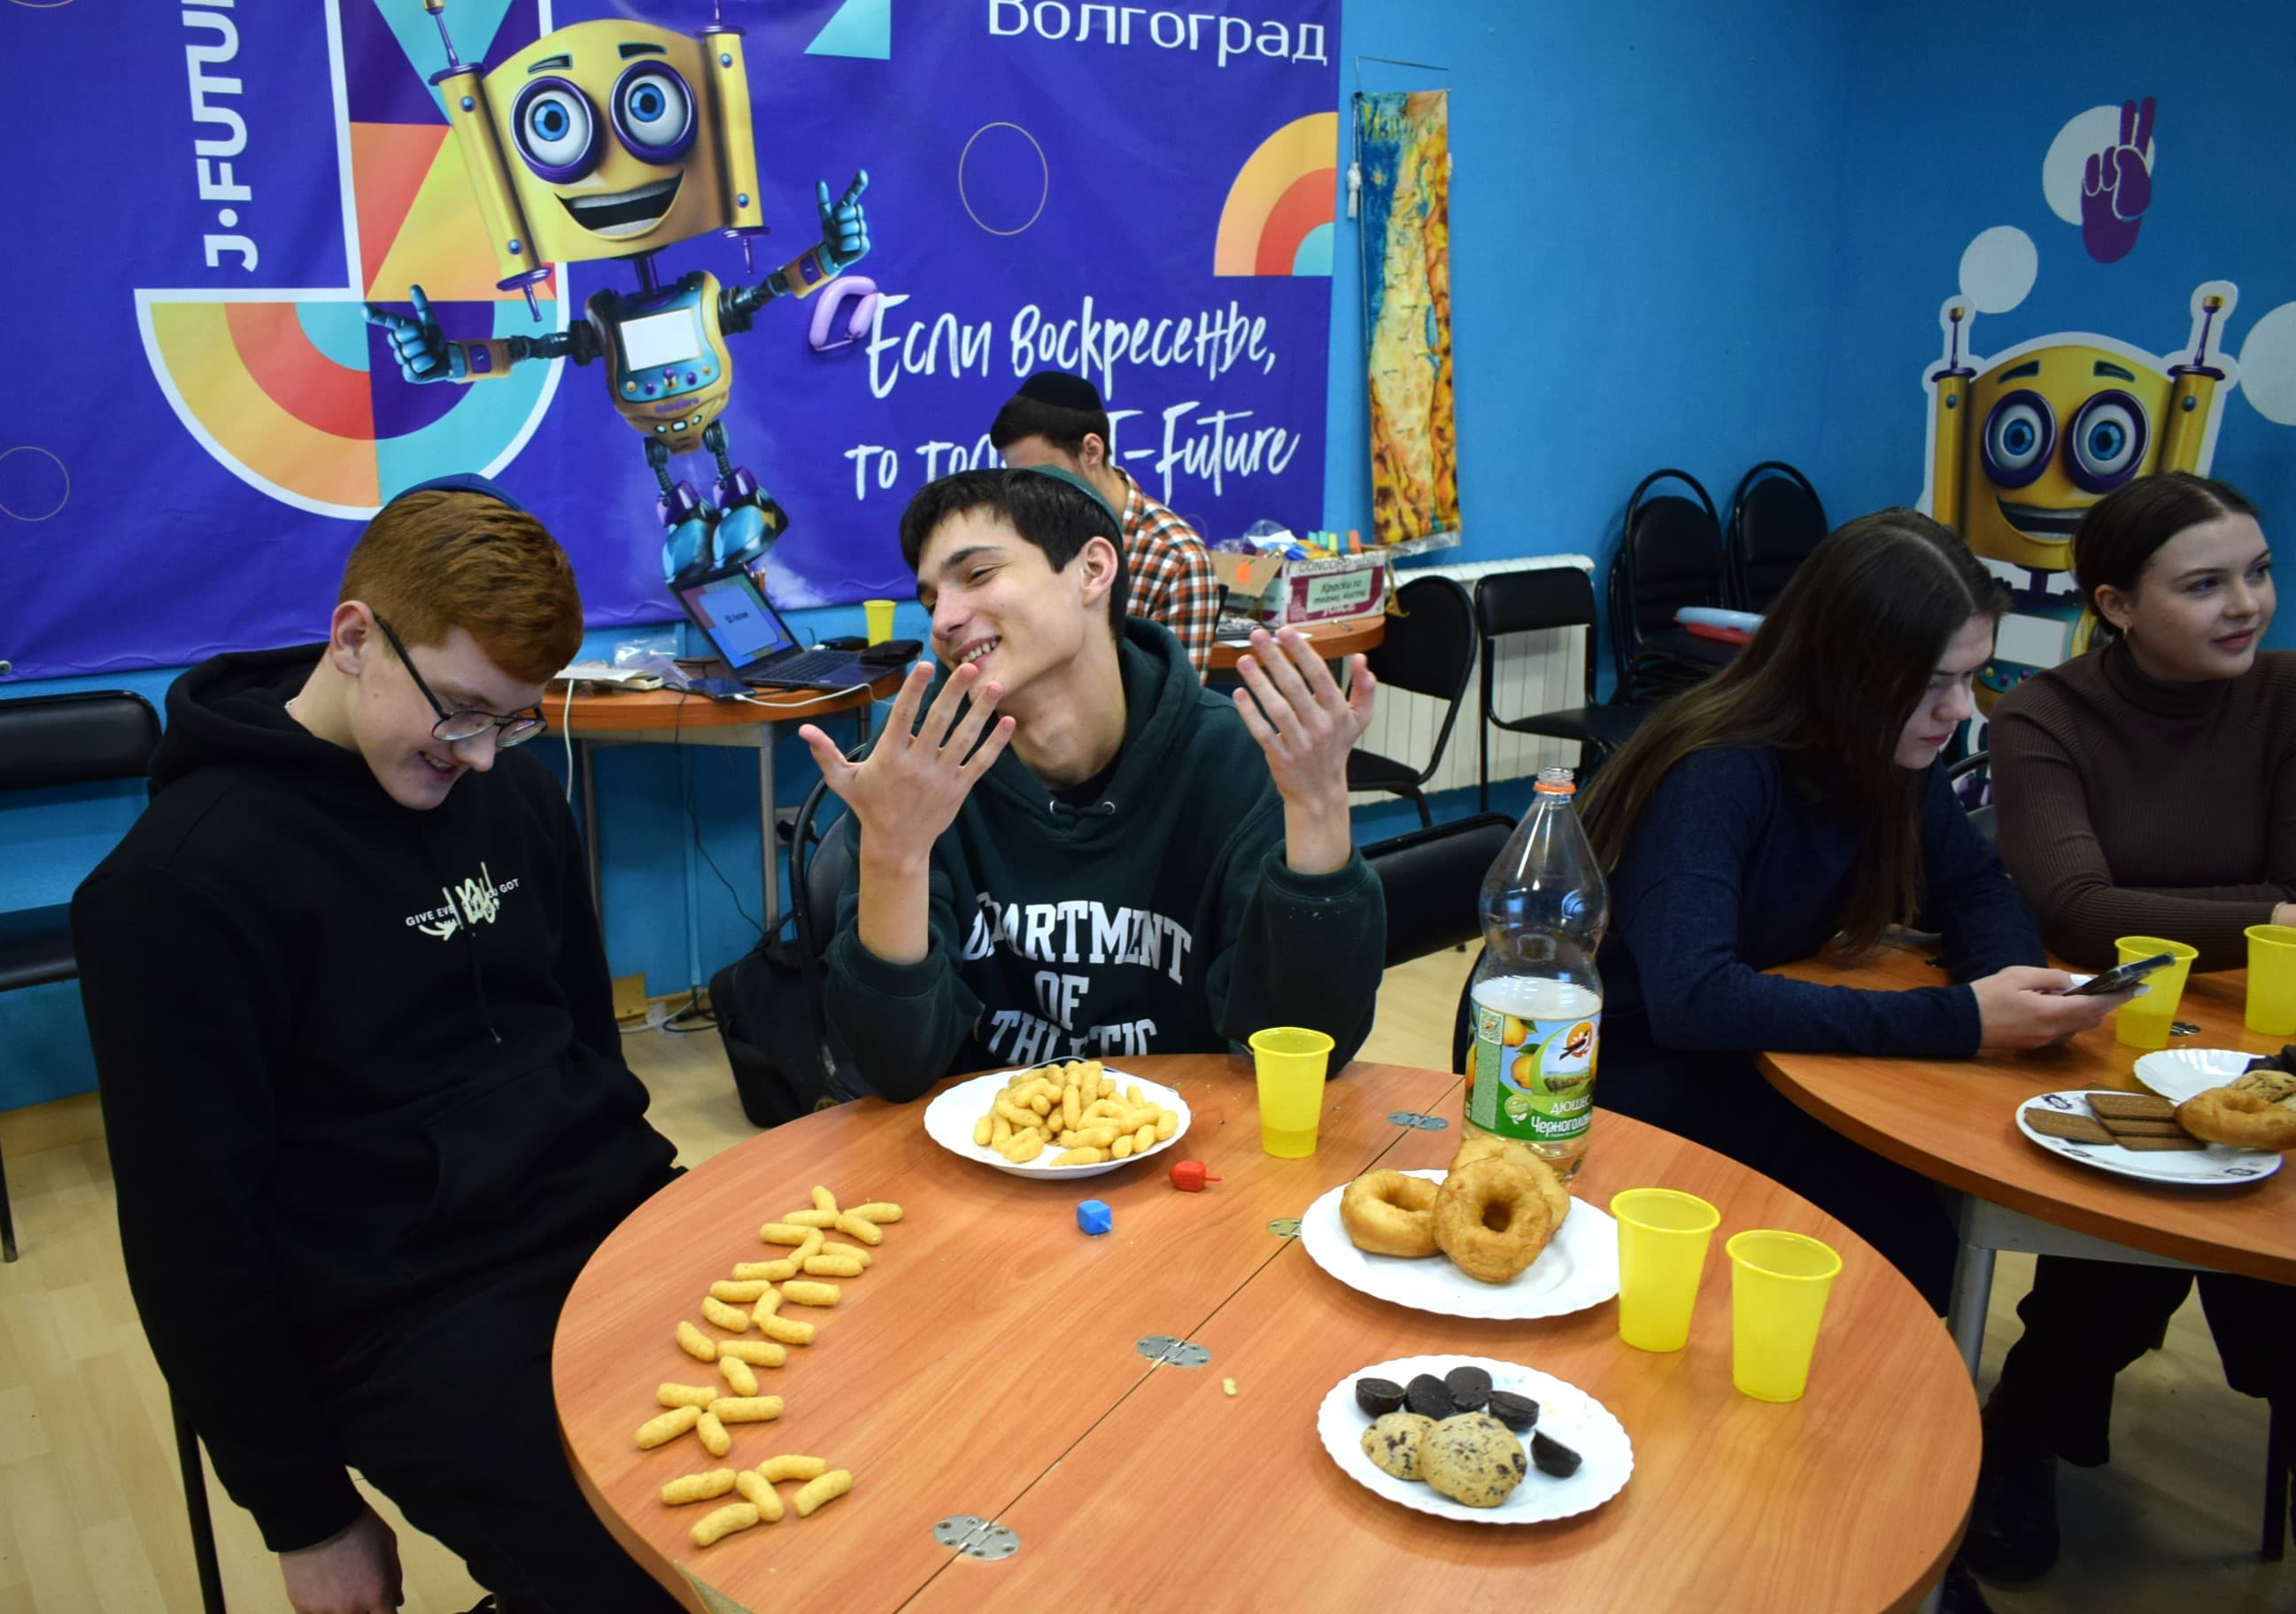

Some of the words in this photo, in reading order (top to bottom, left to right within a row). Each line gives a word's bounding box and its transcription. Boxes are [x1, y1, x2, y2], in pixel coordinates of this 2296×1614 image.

[988, 0, 1327, 67] Волгоград
[866, 292, 992, 398] Если
[406, 910, 435, 927] GIVE
[499, 878, 520, 893] GOT
[1034, 969, 1090, 1031] OF
